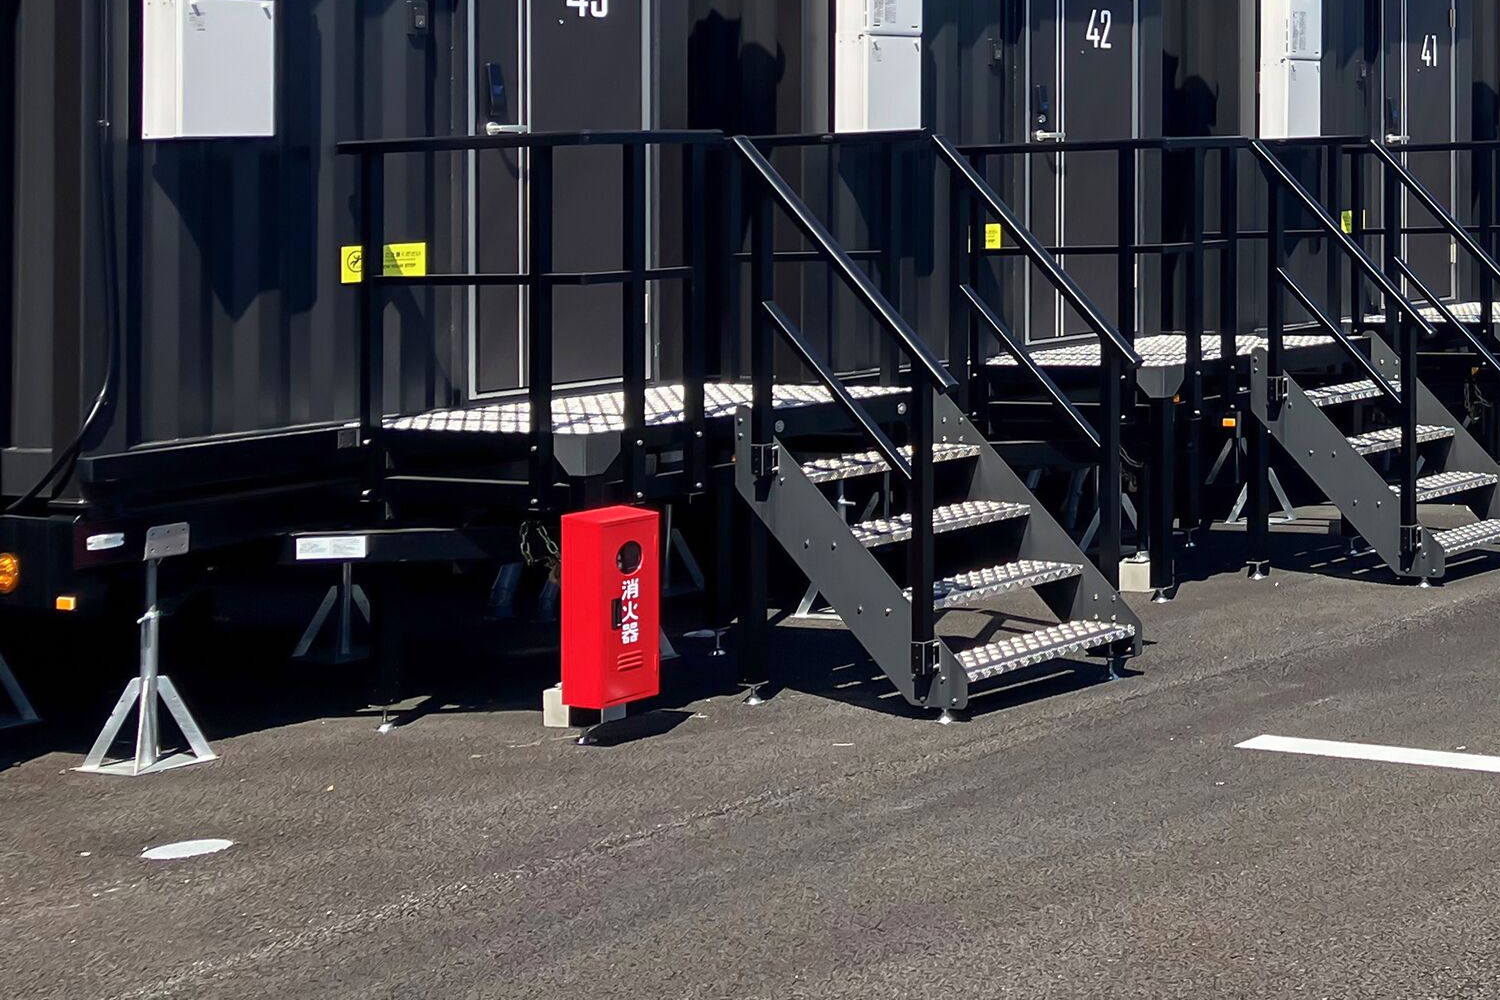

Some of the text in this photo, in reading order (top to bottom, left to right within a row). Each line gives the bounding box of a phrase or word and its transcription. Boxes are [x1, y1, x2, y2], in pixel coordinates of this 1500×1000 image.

[1086, 9, 1112, 49] 42
[1421, 34, 1437, 67] 41
[621, 578, 639, 645] 消火器
